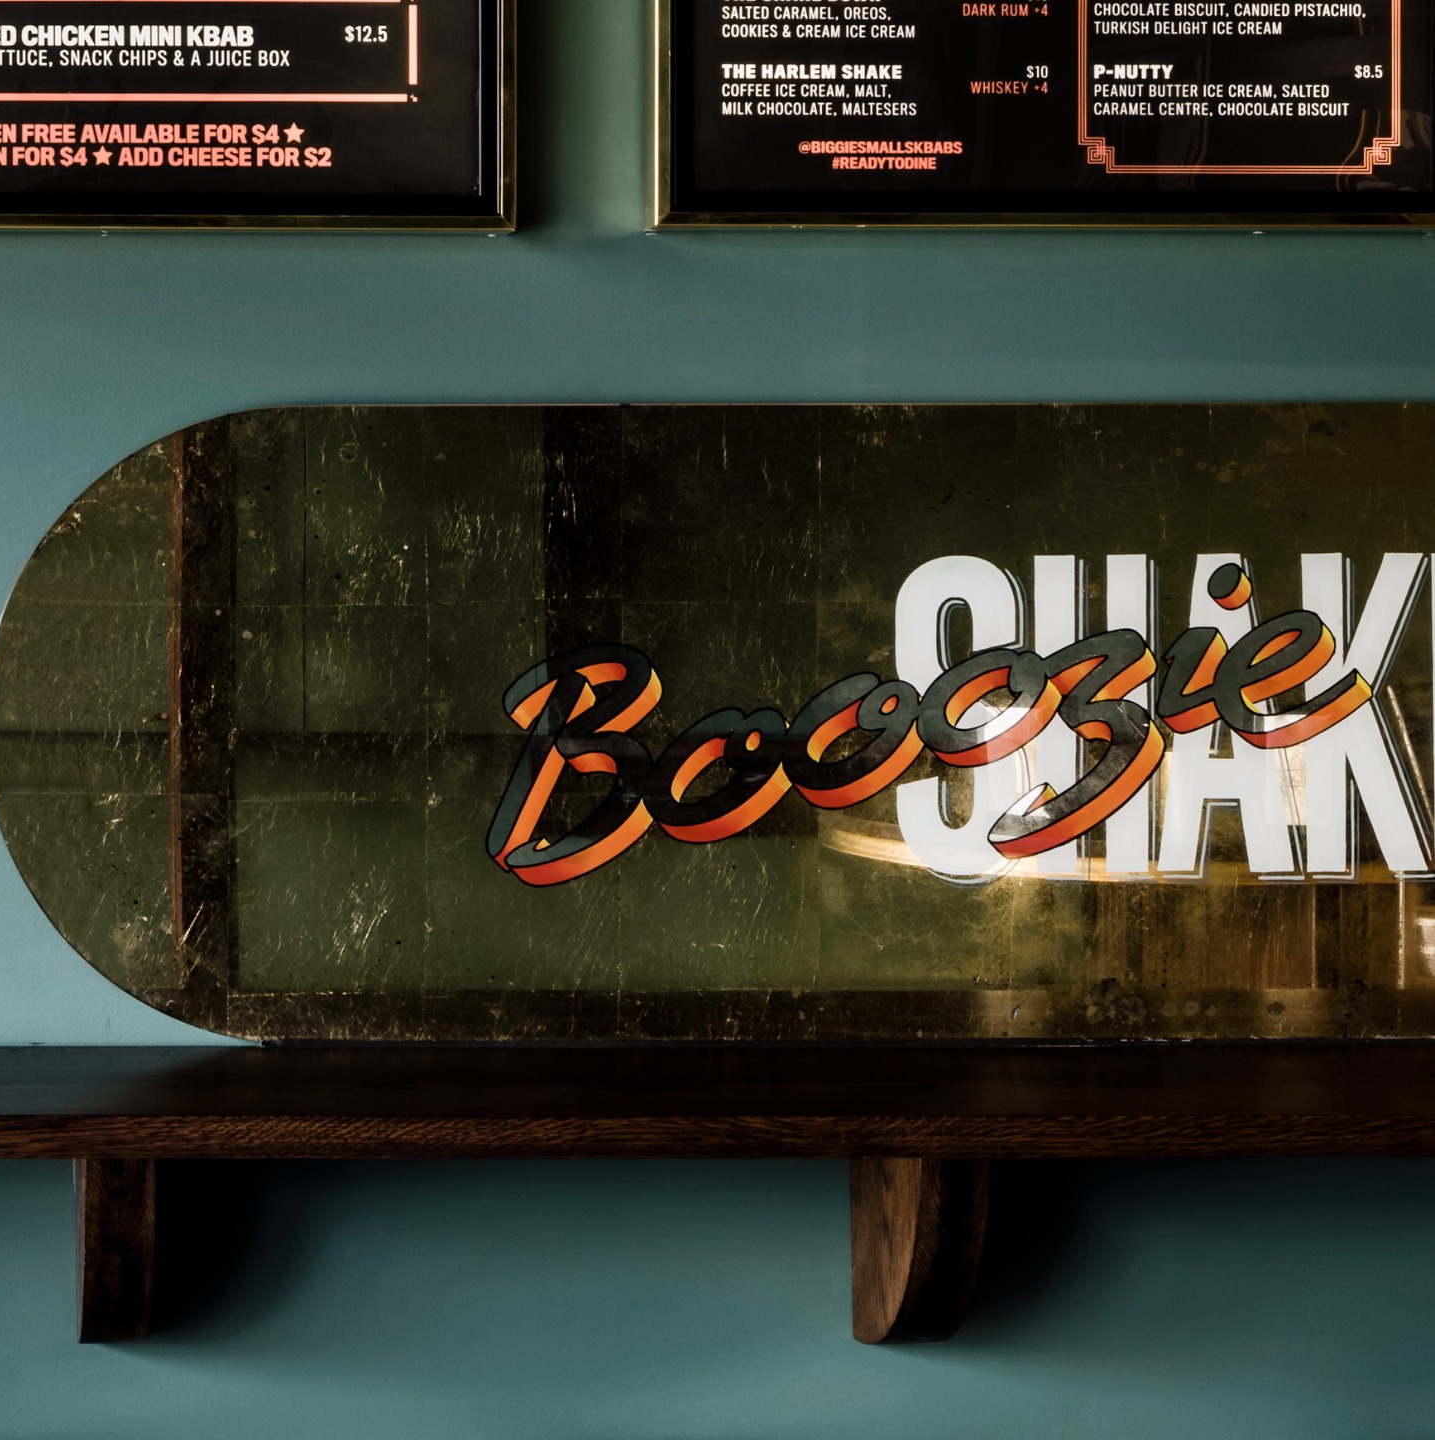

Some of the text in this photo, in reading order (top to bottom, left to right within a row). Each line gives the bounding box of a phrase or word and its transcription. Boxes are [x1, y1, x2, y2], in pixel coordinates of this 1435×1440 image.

[1093, 63, 1174, 80] P-NUTTY
[21, 123, 77, 144] FREE
[79, 123, 200, 144] AVAILABLE
[203, 123, 248, 145] FOR
[251, 123, 281, 146] $4
[798, 140, 963, 155] @BIGGIESMALLSKBABS
[831, 156, 937, 170] #READYTODINE
[894, 552, 1435, 878] SHAK
